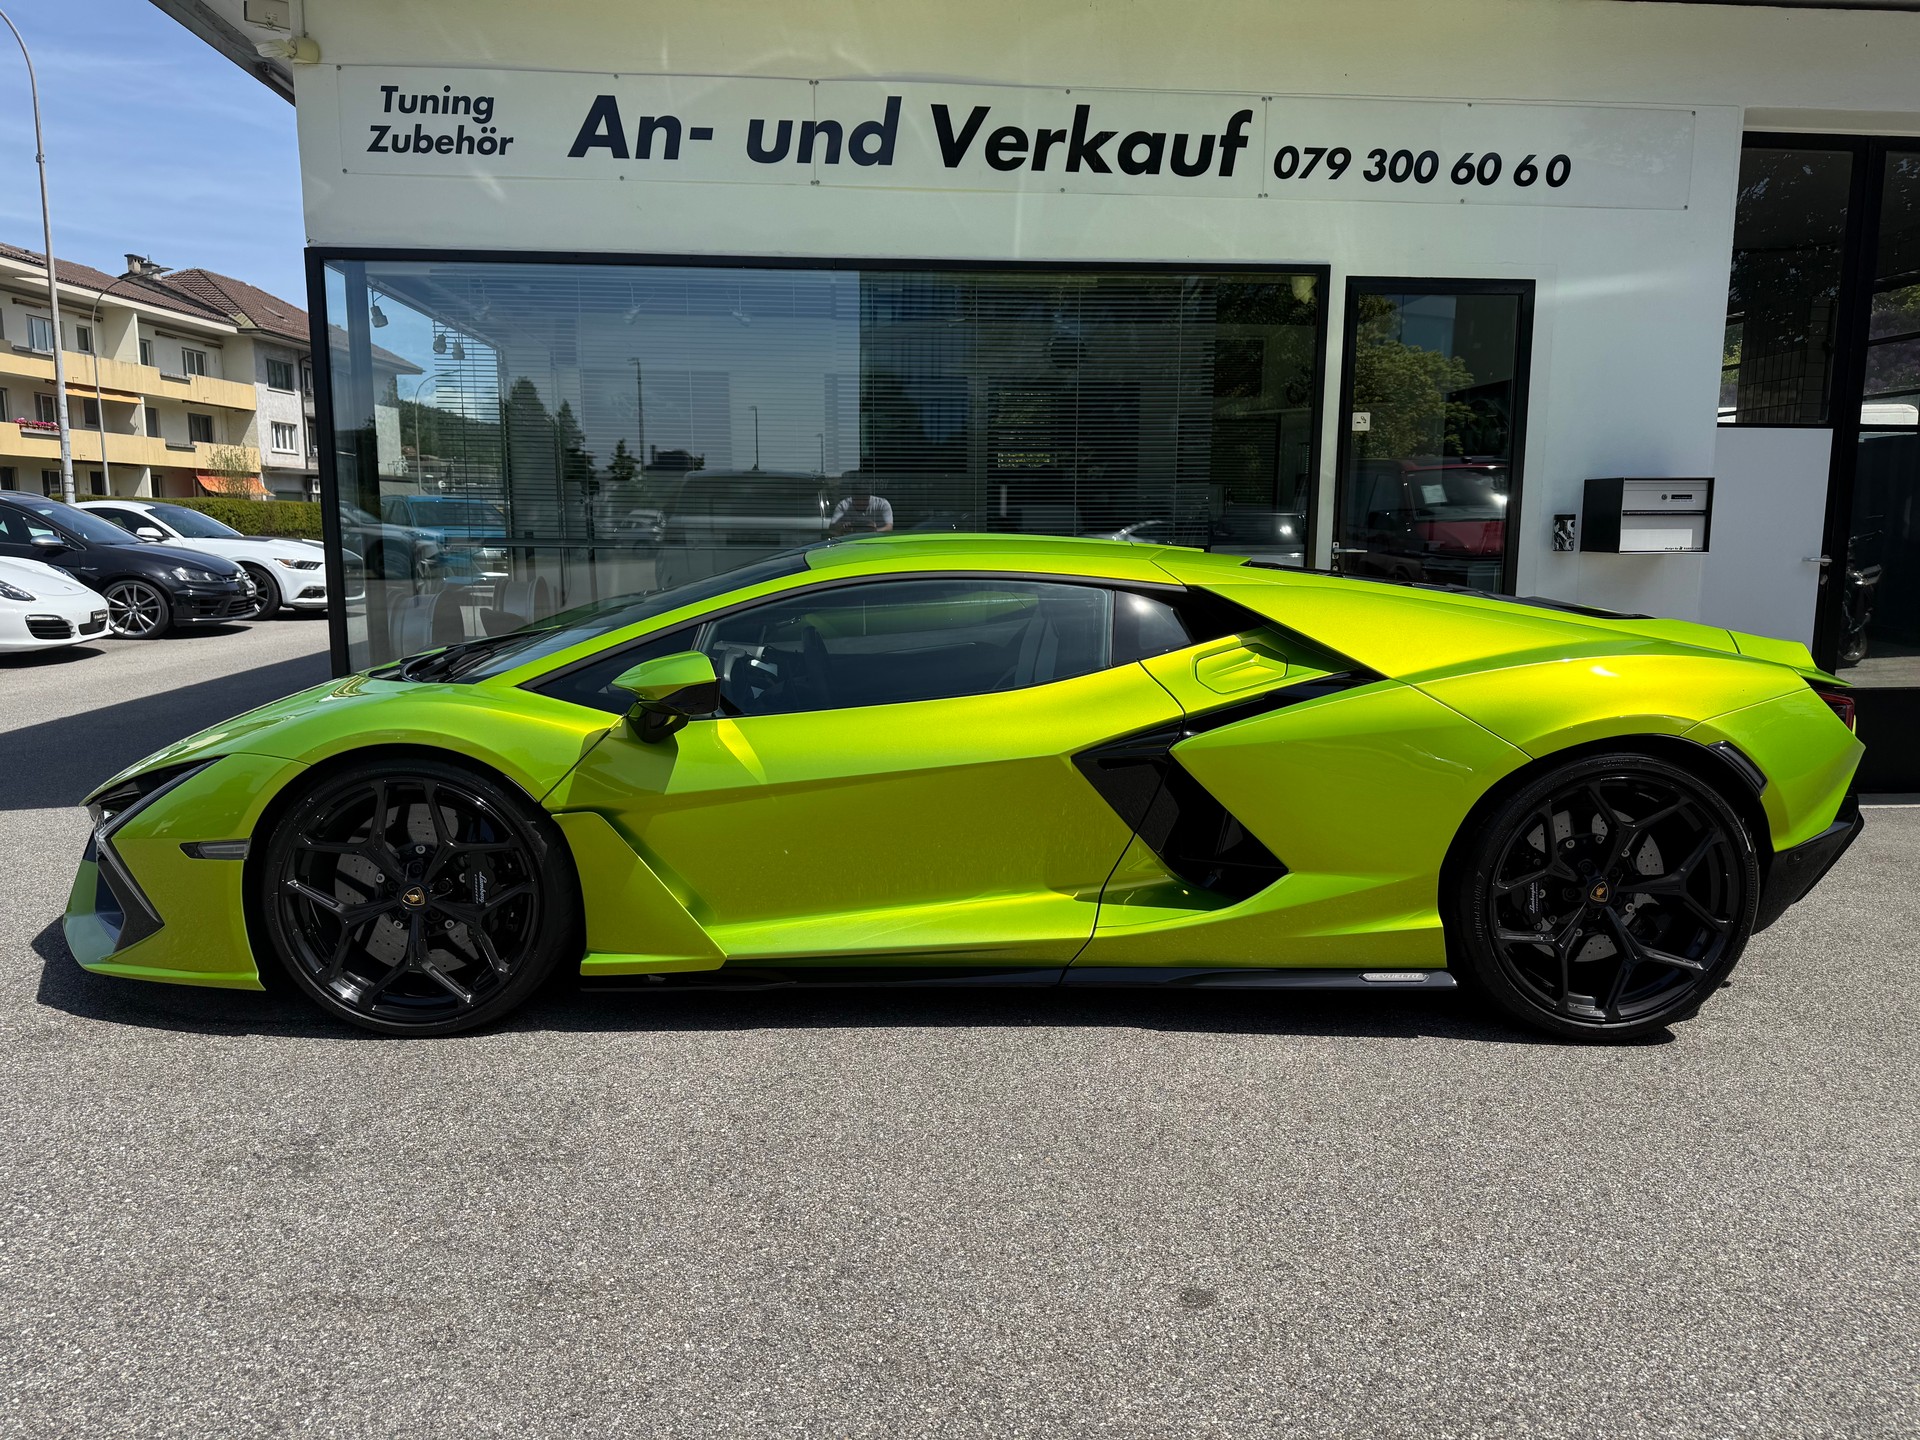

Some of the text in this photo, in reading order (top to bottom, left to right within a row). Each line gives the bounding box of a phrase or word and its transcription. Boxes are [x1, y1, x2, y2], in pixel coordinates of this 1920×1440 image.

[380, 85, 495, 125] Tuning
[366, 124, 514, 156] Zubehör
[567, 94, 1254, 178] An- und Verkauf
[1273, 145, 1572, 188] 079 300 60 60
[479, 871, 487, 903] Lamborg
